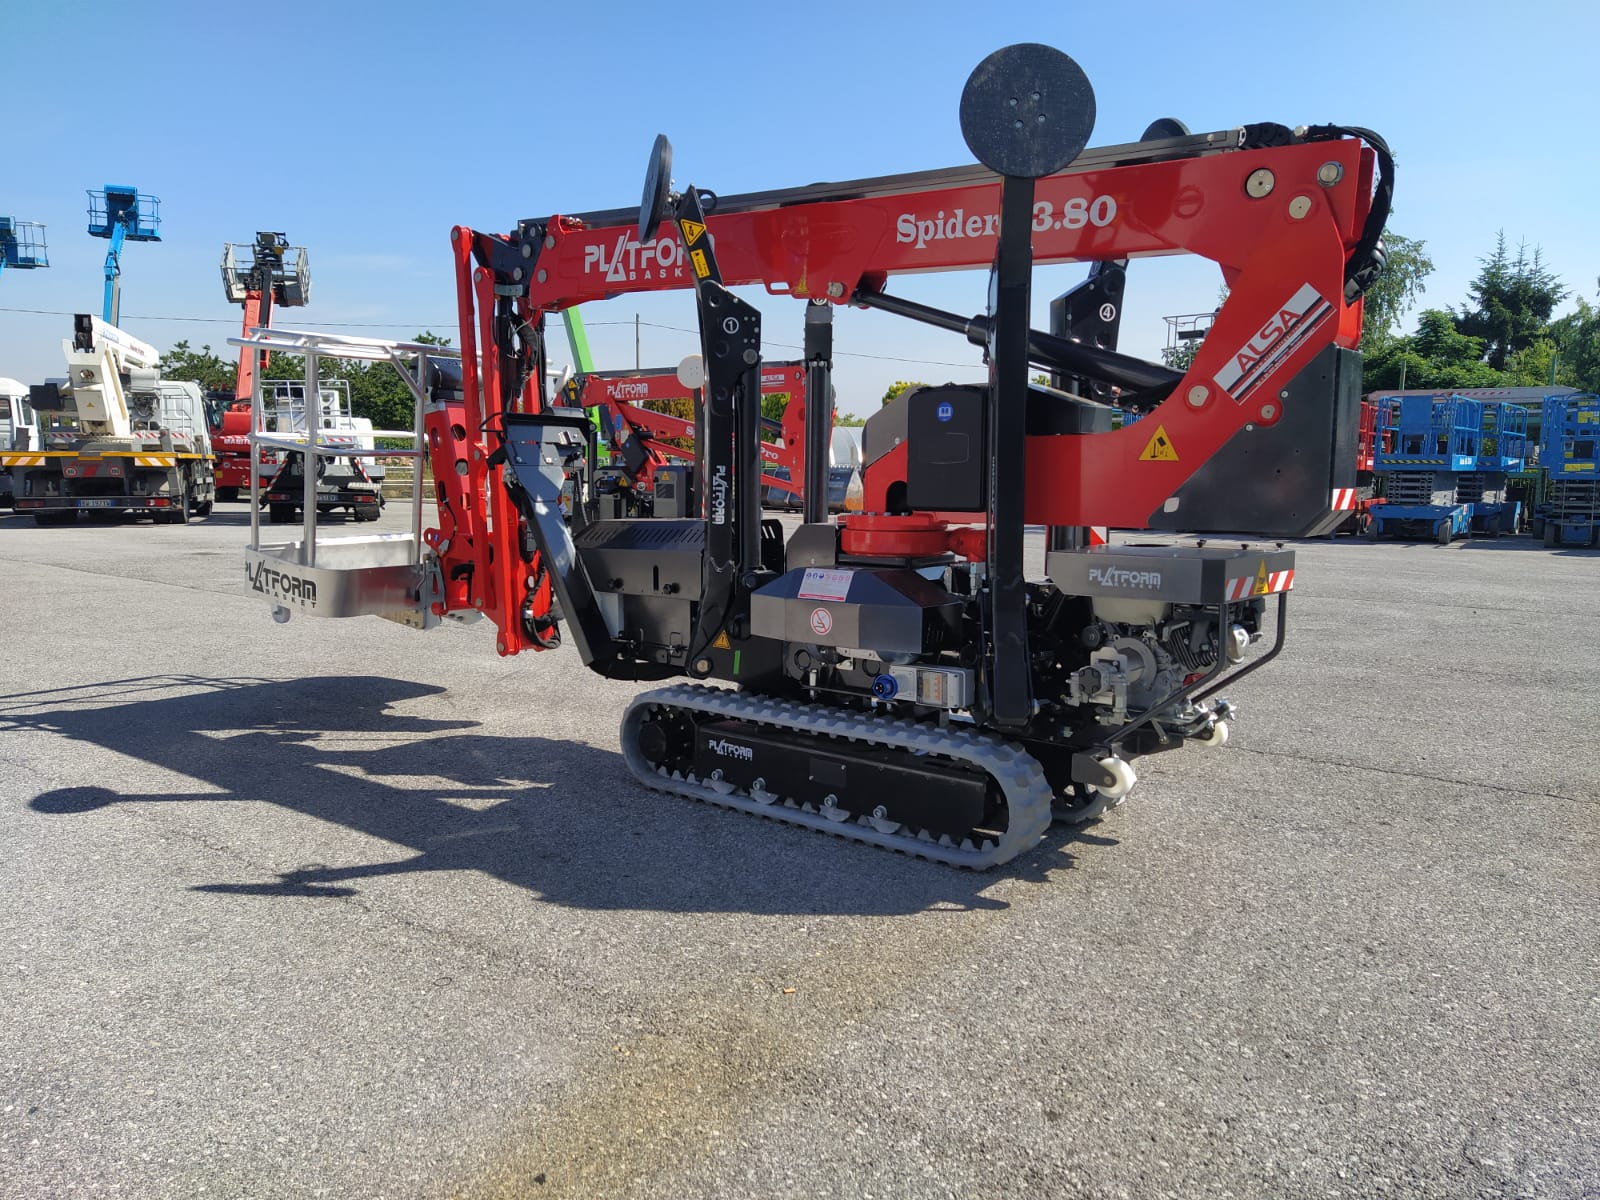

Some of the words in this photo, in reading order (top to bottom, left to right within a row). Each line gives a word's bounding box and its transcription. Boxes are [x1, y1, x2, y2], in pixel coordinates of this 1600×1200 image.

[896, 208, 999, 248] Spider
[1031, 195, 1117, 232] 3.80
[584, 229, 715, 282] PLATFO
[629, 267, 683, 280] BASK
[1236, 309, 1301, 375] ALSA
[607, 380, 649, 399] PLATFORM
[712, 465, 729, 525] PLATFORM
[1088, 565, 1161, 586] PLATFORM
[708, 739, 753, 758] PLATFORM
